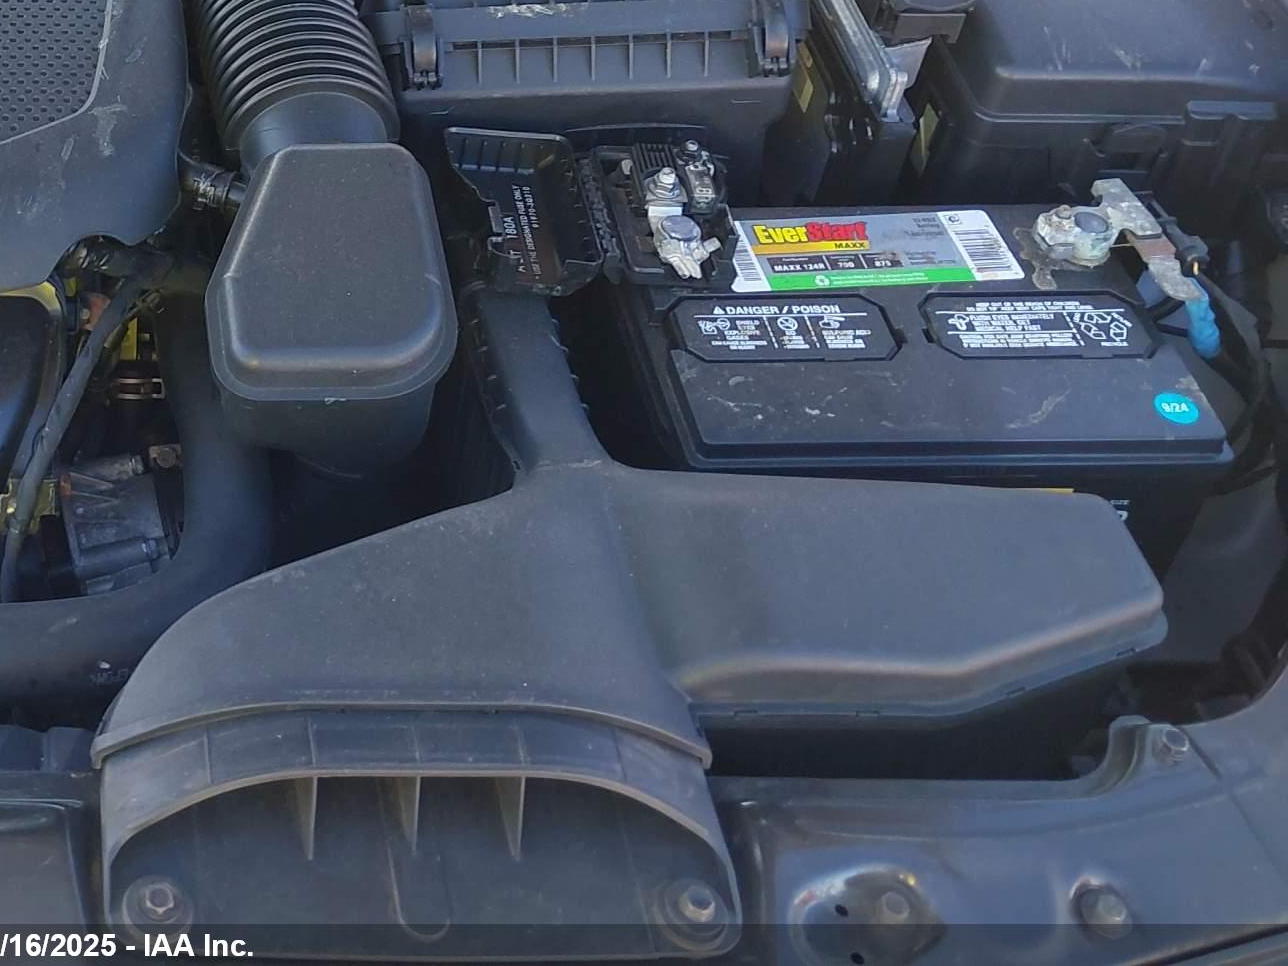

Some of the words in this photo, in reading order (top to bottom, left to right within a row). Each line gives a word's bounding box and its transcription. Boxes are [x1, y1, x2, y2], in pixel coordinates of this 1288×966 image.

[503, 216, 519, 238] 180A
[752, 221, 868, 244] EverStart
[725, 306, 780, 315] DANGER
[782, 306, 789, 314] /
[791, 305, 841, 314] POISON
[1161, 402, 1190, 413] 9/24
